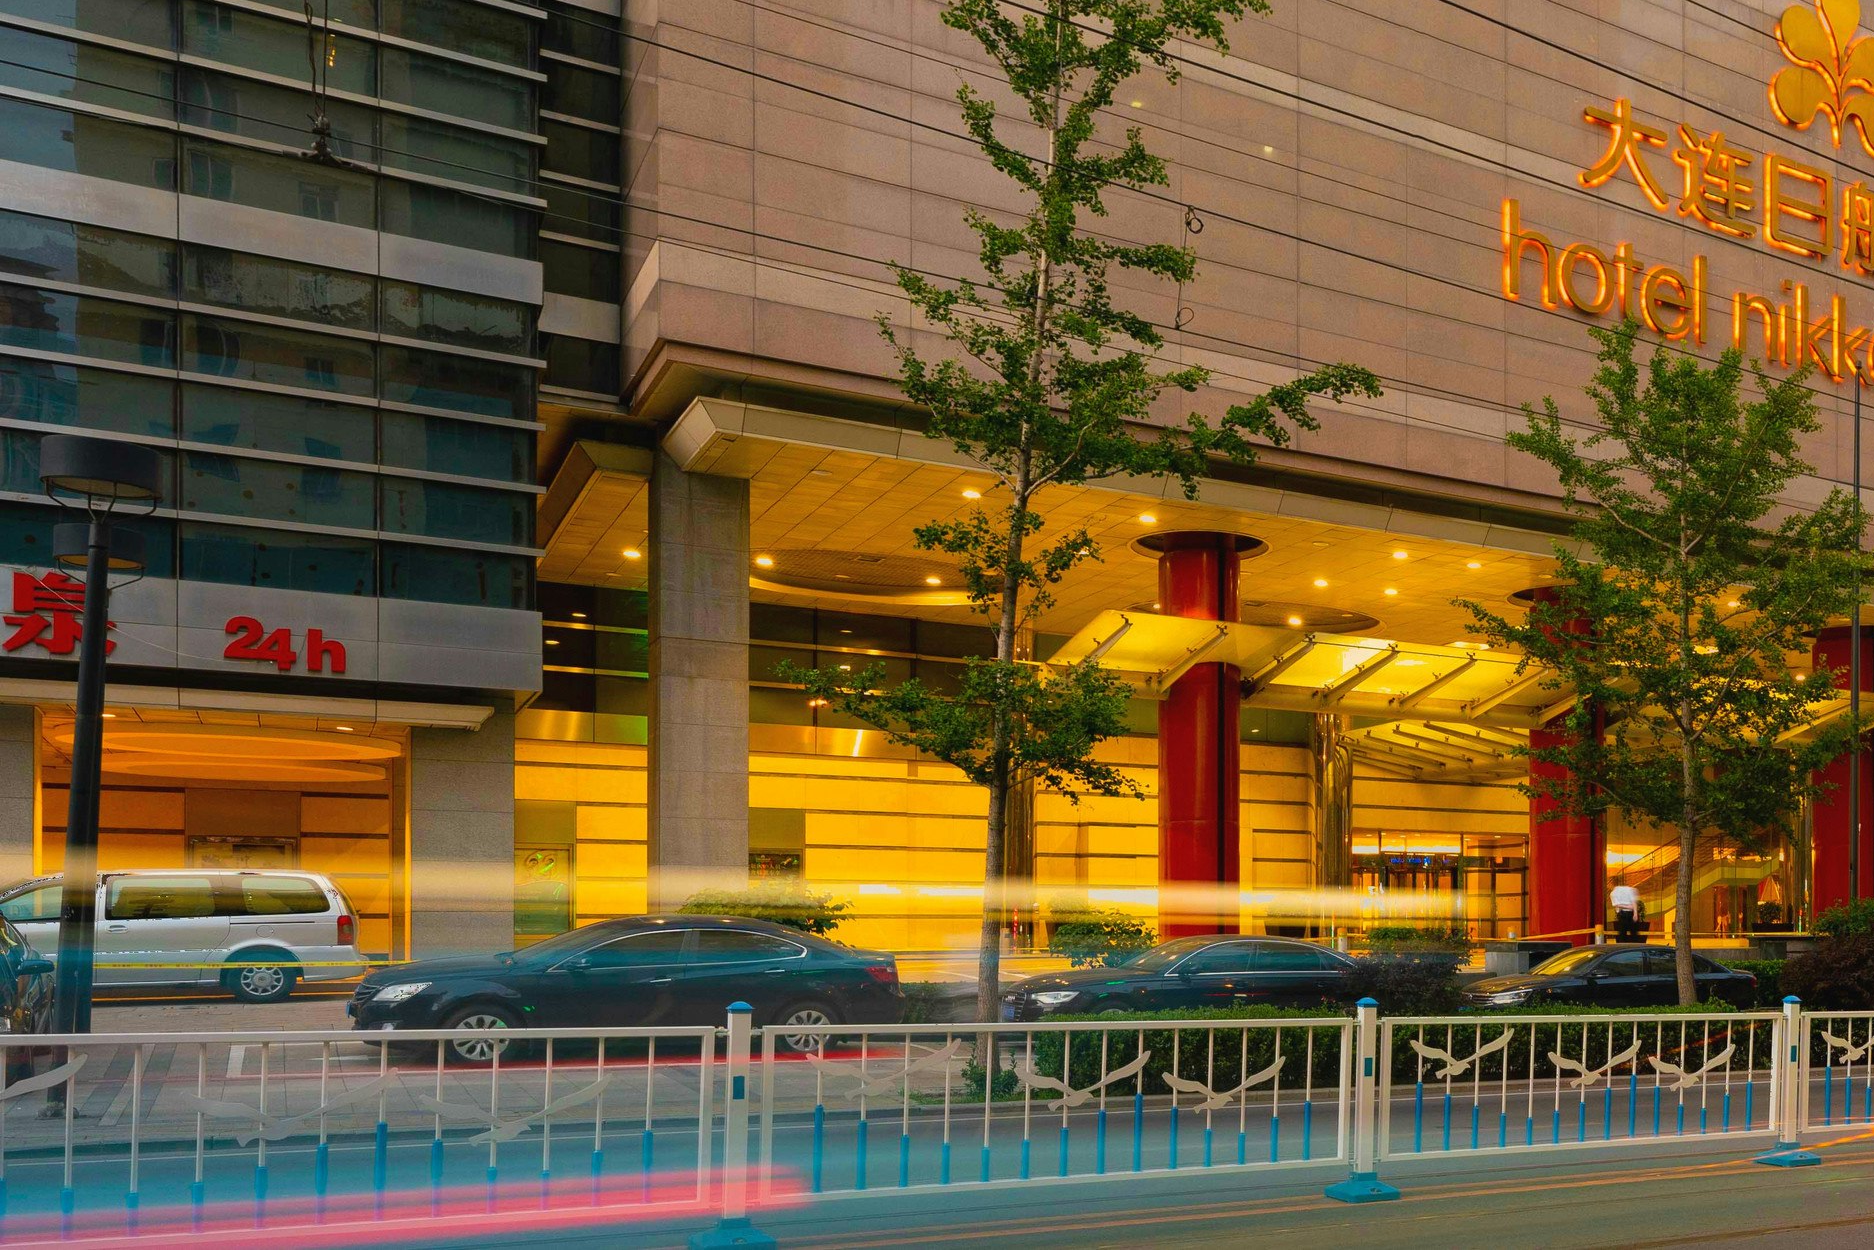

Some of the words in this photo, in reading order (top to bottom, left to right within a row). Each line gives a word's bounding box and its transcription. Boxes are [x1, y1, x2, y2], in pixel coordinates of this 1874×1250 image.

[1502, 198, 1708, 344] hotel
[2, 571, 117, 656] 泉
[223, 616, 346, 674] 24h
